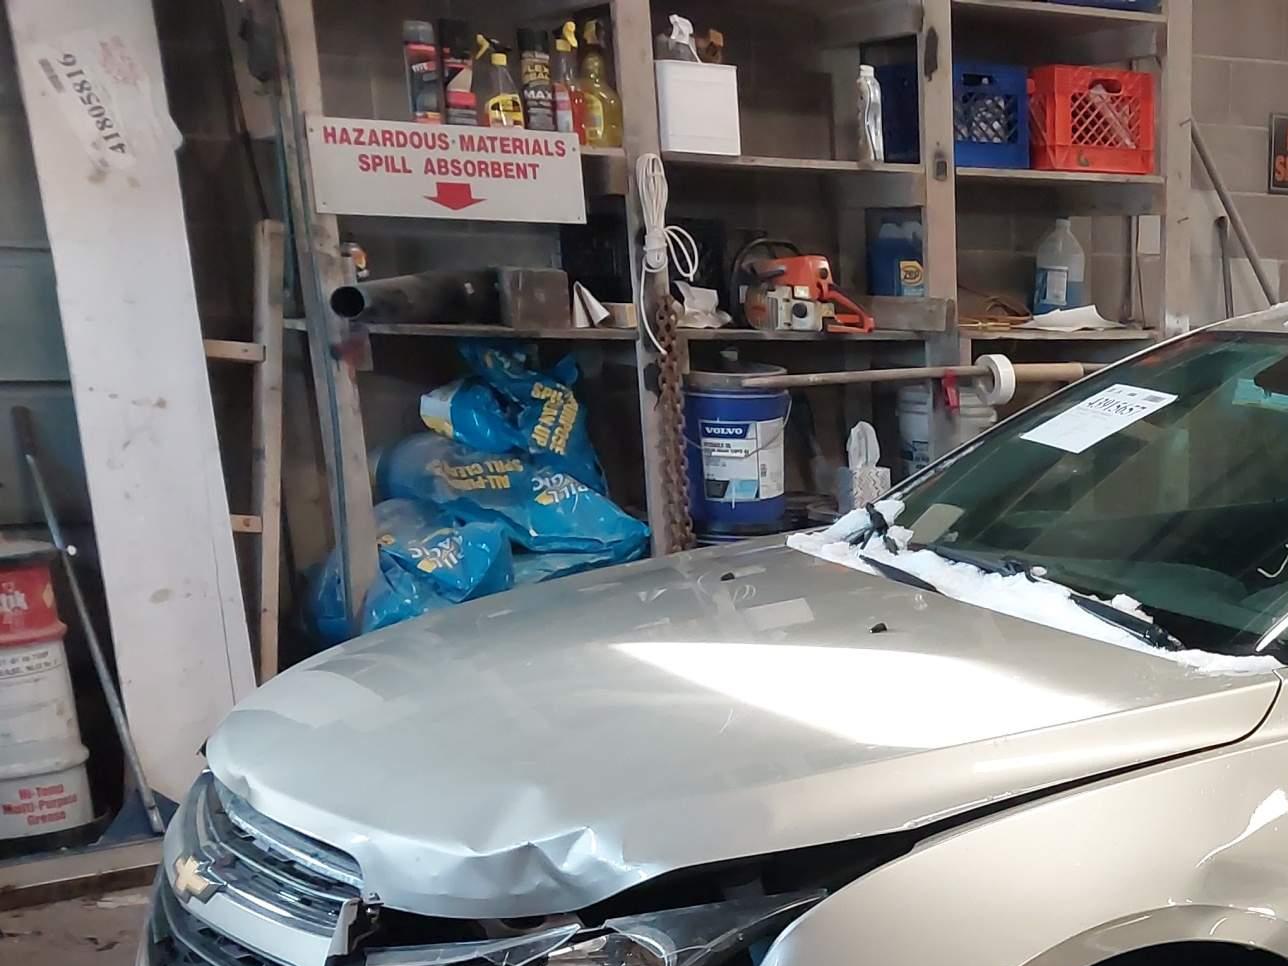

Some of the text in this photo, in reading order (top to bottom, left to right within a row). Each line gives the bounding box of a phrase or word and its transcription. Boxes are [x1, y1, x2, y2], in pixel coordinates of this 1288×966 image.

[57, 53, 126, 154] 41805816
[524, 88, 553, 100] MAX
[322, 125, 566, 158] HAZARDOUS MATERIALS
[358, 153, 540, 180] SPILL ABSORBENT
[704, 426, 743, 435] VOLVO
